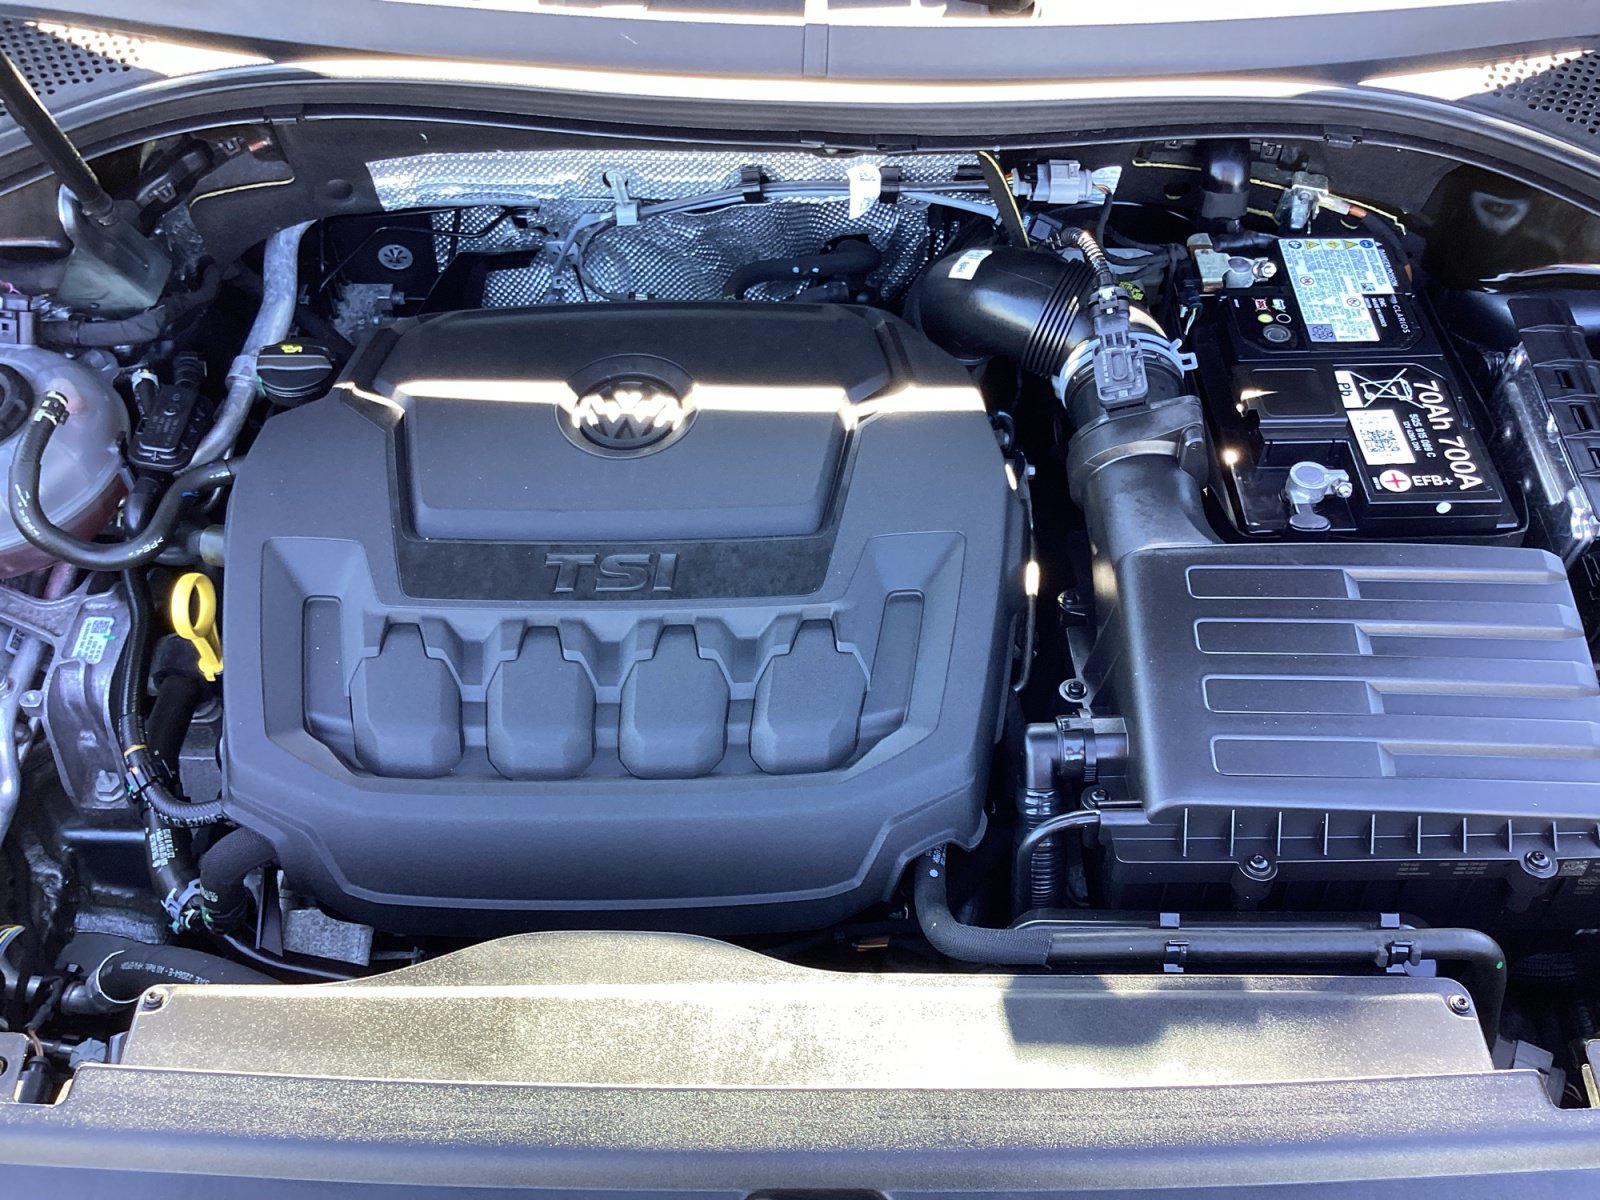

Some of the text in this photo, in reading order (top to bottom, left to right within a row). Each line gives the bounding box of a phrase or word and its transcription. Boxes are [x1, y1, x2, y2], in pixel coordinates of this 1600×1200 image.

[1393, 304, 1411, 334] CLARIOS
[1339, 382, 1353, 397] Pb
[1413, 380, 1483, 490] 70Ah 700A
[1412, 474, 1453, 486] EFB+
[545, 552, 680, 593] TSI
